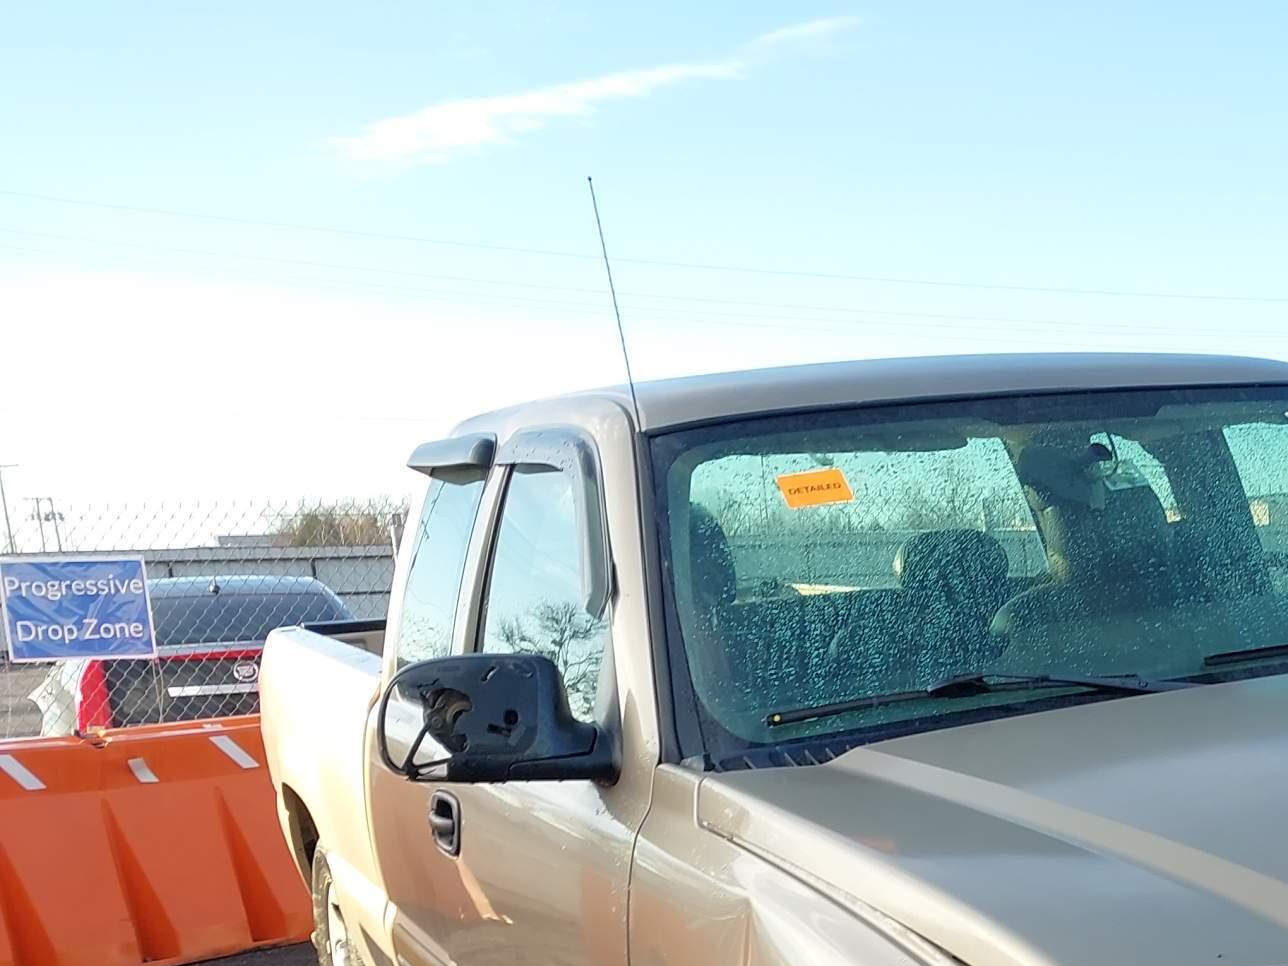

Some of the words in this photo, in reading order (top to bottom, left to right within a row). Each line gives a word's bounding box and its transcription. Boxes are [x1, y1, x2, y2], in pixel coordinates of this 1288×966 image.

[788, 482, 842, 496] DETAILED
[4, 574, 143, 601] Progressive
[16, 620, 78, 644] Drop
[82, 619, 143, 640] Zone
